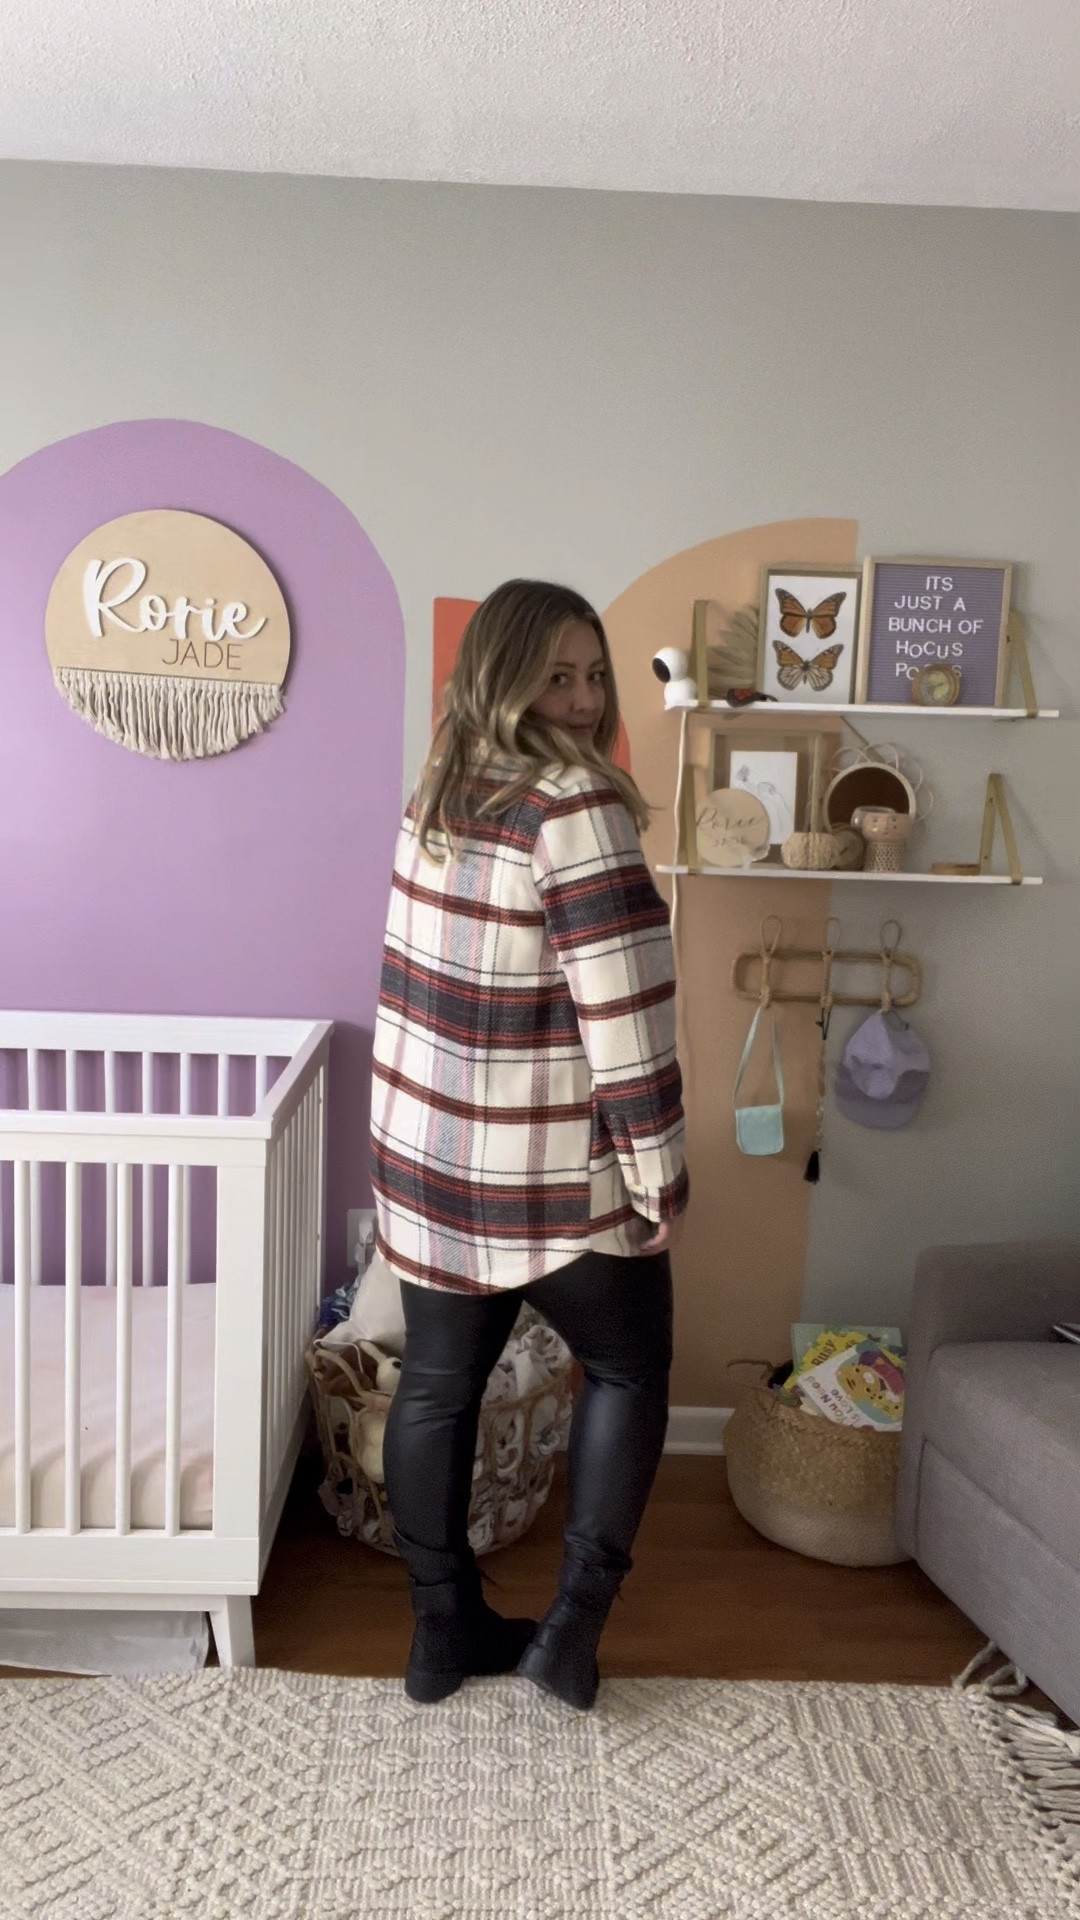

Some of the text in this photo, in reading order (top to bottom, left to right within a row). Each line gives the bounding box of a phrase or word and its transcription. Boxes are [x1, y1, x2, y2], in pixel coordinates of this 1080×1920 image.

[926, 576, 953, 592] ITS
[83, 557, 269, 642] Rorie
[894, 595, 966, 612] JUST A
[888, 617, 984, 635] BUNCH OF
[162, 638, 243, 671] JADE
[896, 640, 963, 659] HOCUS
[895, 662, 962, 680] POS
